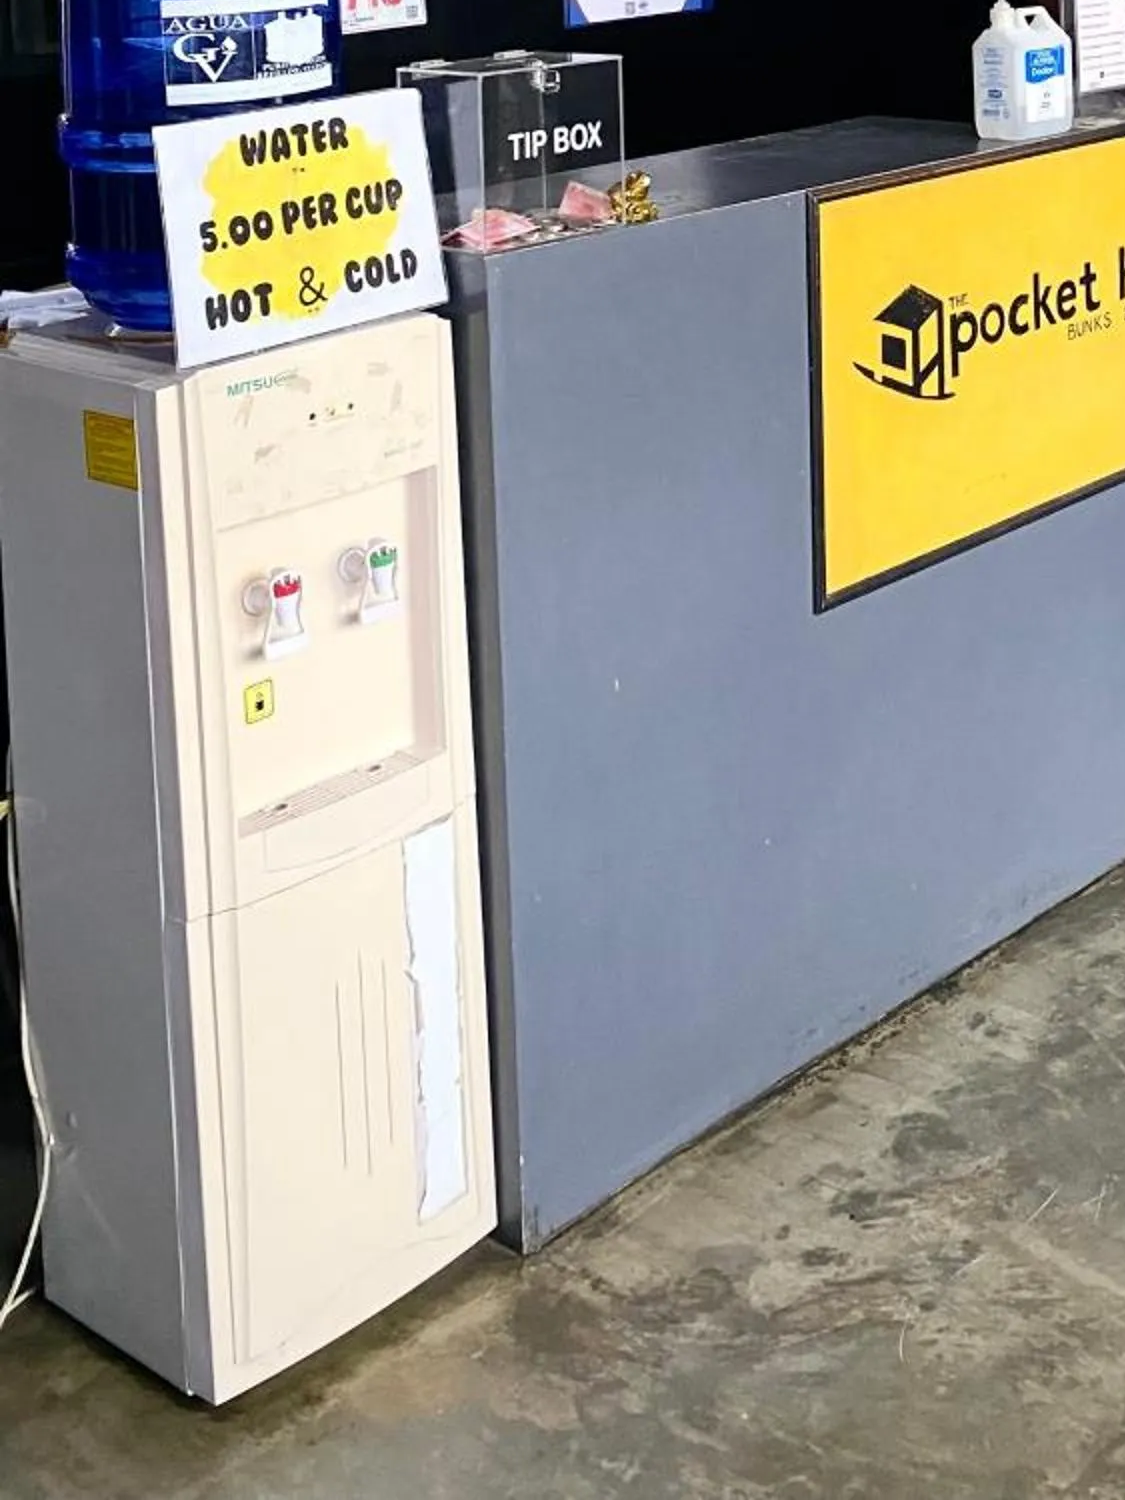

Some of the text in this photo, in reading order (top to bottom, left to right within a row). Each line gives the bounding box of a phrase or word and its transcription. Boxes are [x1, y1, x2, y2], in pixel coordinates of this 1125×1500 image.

[165, 14, 250, 34] AGUA
[239, 117, 349, 166] WATER
[507, 120, 602, 160] TIP BOX
[199, 178, 403, 253] 5.00 PER CUP
[205, 248, 418, 330] HOT & COLD
[950, 292, 969, 310] THE
[949, 261, 1101, 378] pocket
[1067, 310, 1112, 341] BUNKS
